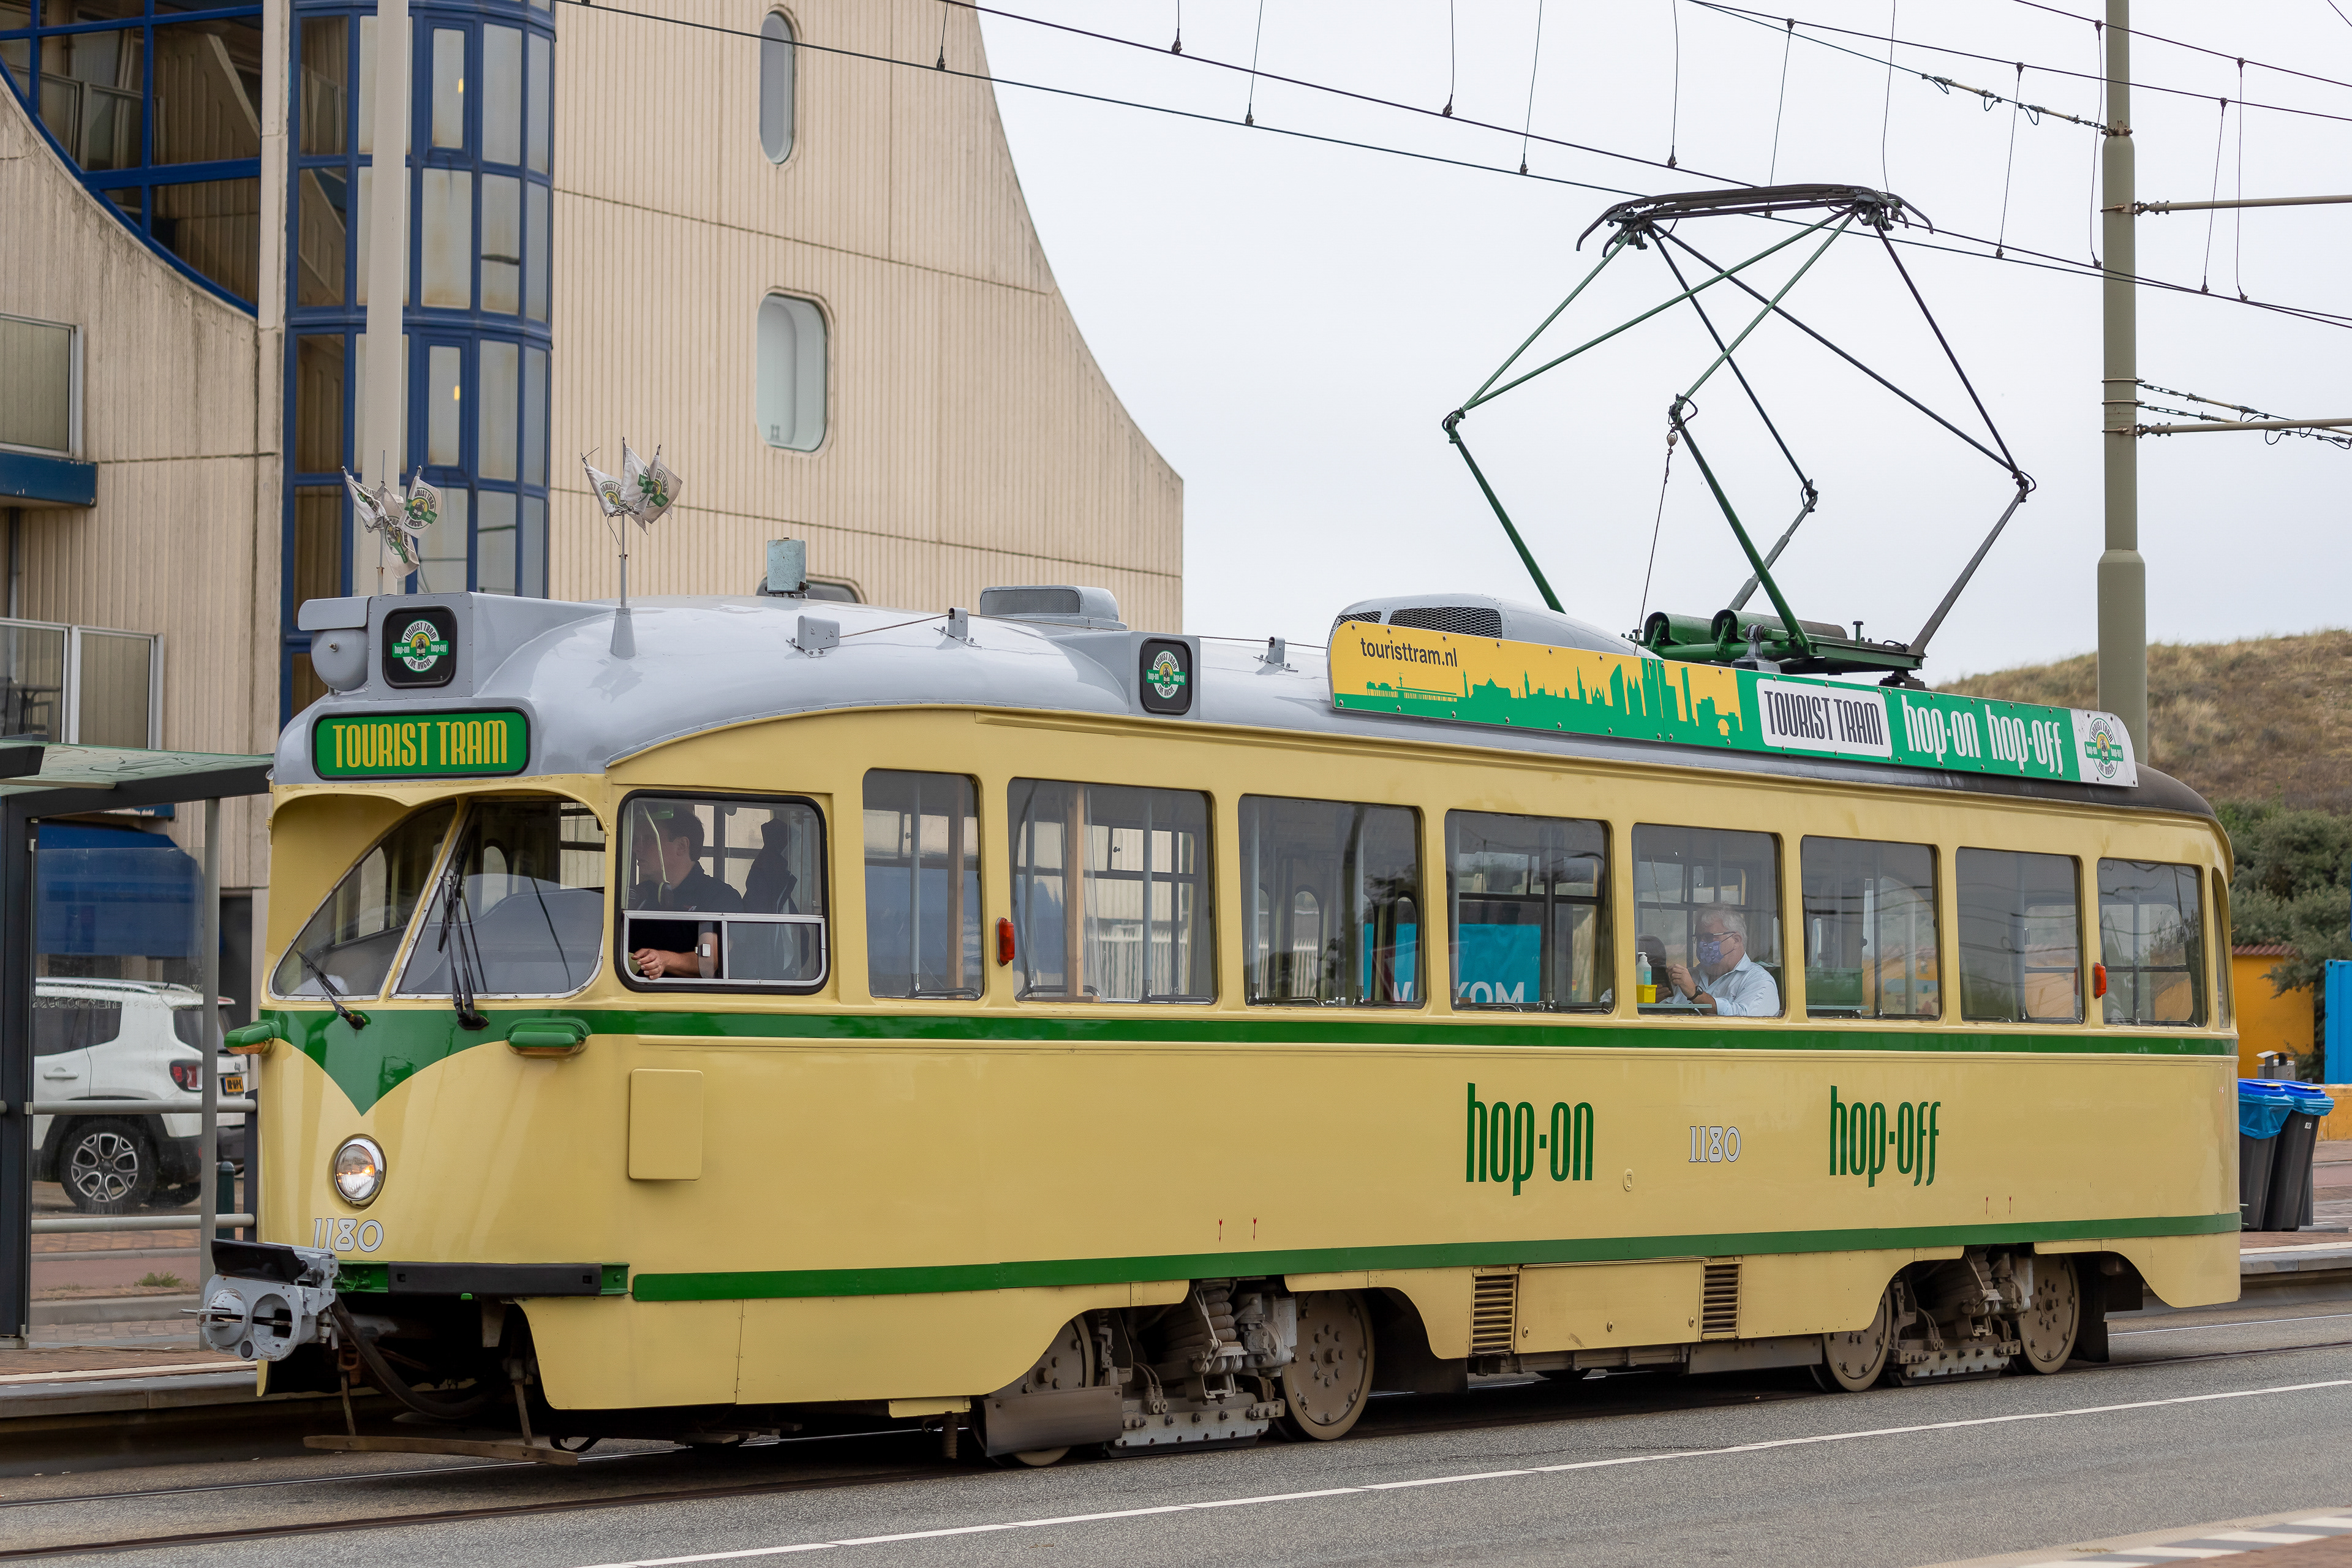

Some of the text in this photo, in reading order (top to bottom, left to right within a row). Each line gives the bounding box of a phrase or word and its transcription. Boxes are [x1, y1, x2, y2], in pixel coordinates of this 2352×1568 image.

[404, 622, 437, 642] TOURIST TRAM
[394, 644, 447, 654] hop-on hop-off
[408, 657, 432, 669] THE HAGUE
[1154, 652, 1178, 670] TOURIST TRAM
[1360, 638, 1457, 667] touristtram.nl
[1148, 671, 1185, 683] hop-on hop-off
[1764, 691, 1883, 745] TOURIST TRAM
[2091, 721, 2113, 742] TOURIST TRAM
[333, 720, 507, 768] TOURIST TRAM
[1901, 695, 2063, 774] hop-on hop-off
[1466, 1082, 1594, 1196] hop-on
[1688, 1126, 1741, 1163] 1180
[1830, 1085, 1941, 1188] hop-off
[313, 1218, 384, 1253] 1180
